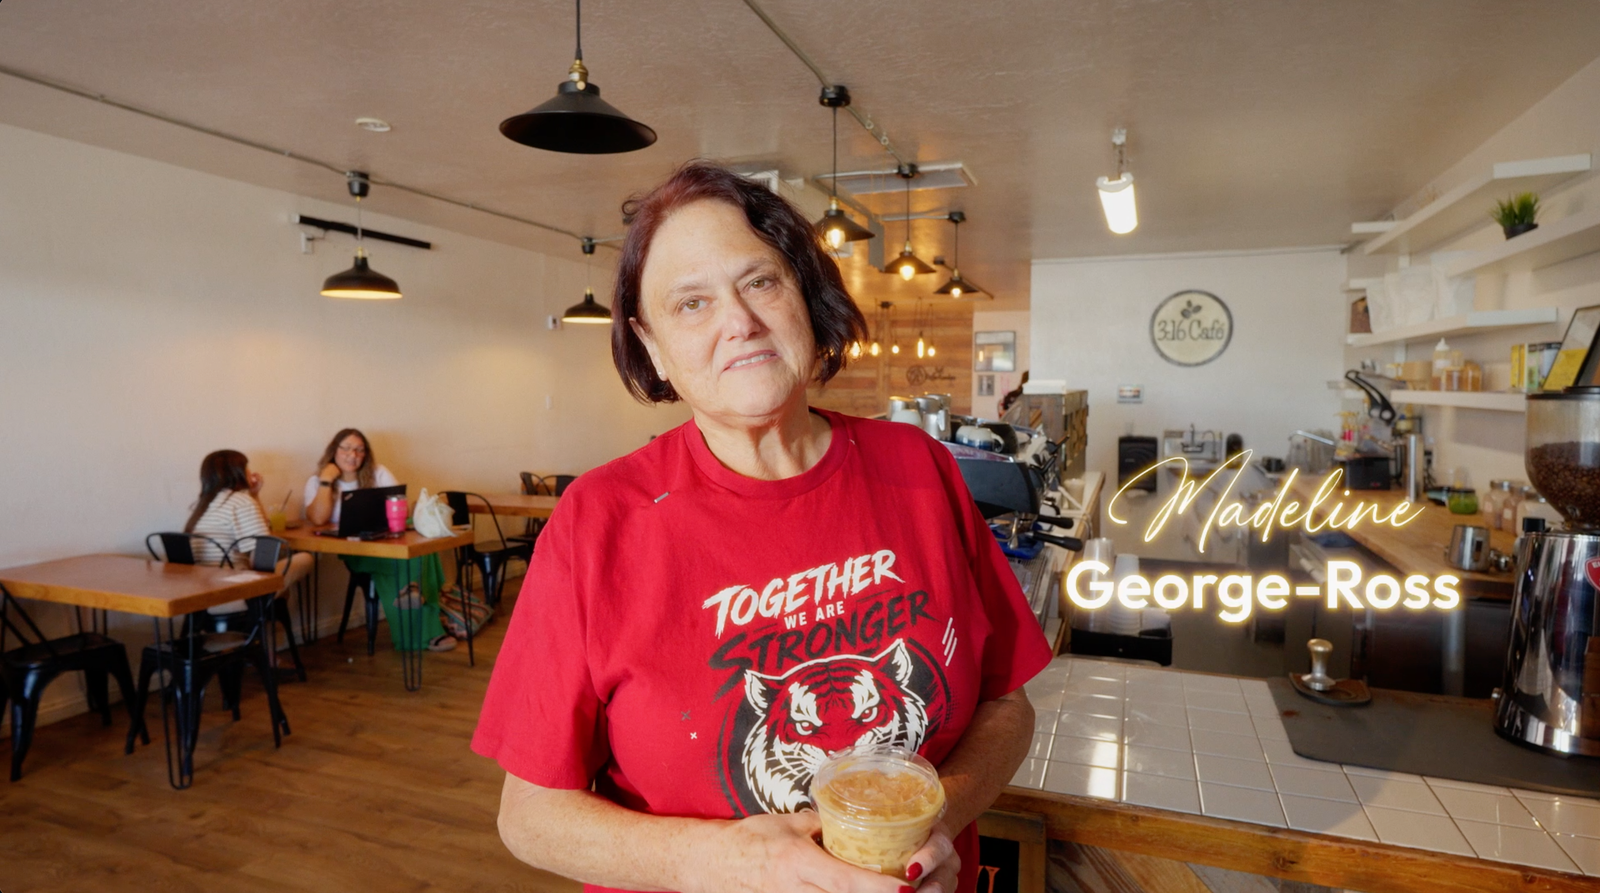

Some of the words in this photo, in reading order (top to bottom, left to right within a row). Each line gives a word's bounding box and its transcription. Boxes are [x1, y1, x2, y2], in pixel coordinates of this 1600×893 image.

[1157, 318, 1187, 341] 3:16
[1188, 318, 1225, 341] Café
[702, 549, 906, 639] TOGETHER
[784, 611, 808, 630] WE
[815, 601, 845, 622] ARE
[708, 590, 942, 702] STRONGER
